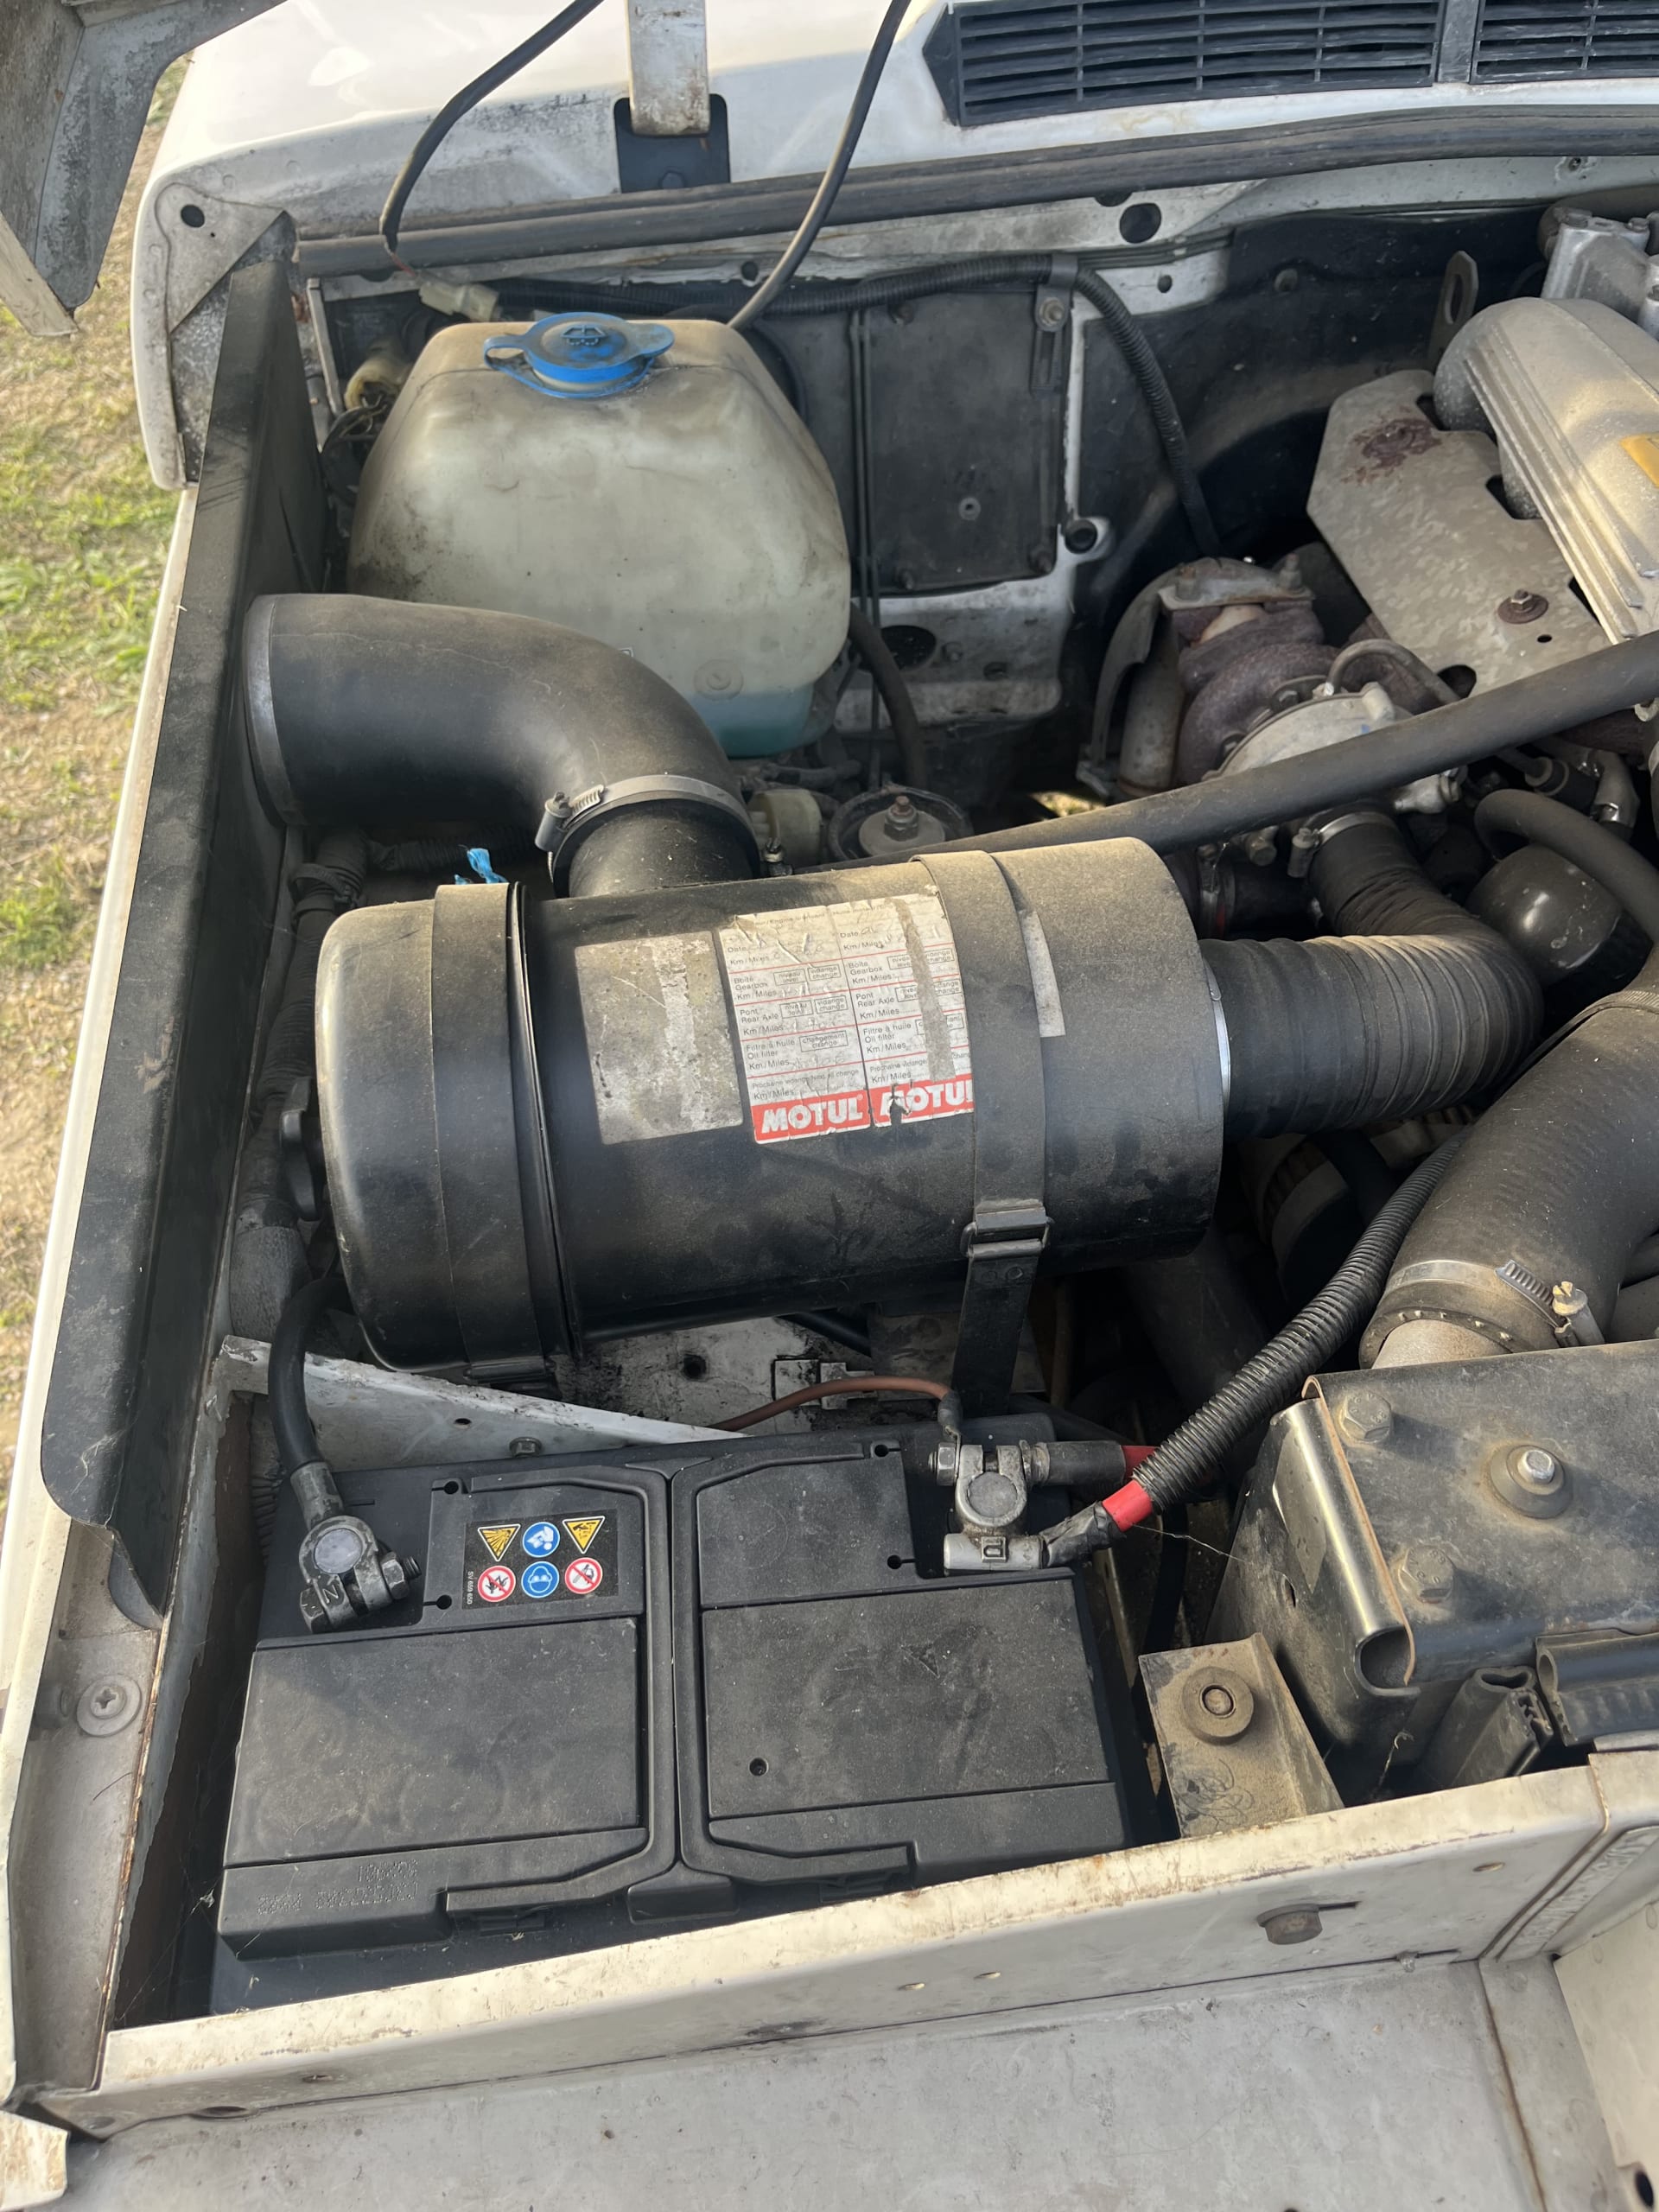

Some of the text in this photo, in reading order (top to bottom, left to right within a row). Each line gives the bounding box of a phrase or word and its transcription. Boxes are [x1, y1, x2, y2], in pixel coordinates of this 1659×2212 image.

[850, 966, 882, 976] Gearbox
[734, 982, 768, 991] Gearbox
[776, 1039, 796, 1047] huile
[870, 1063, 900, 1072] Prochaine
[761, 1096, 863, 1134] MOTUL
[322, 1584, 339, 1604] N
